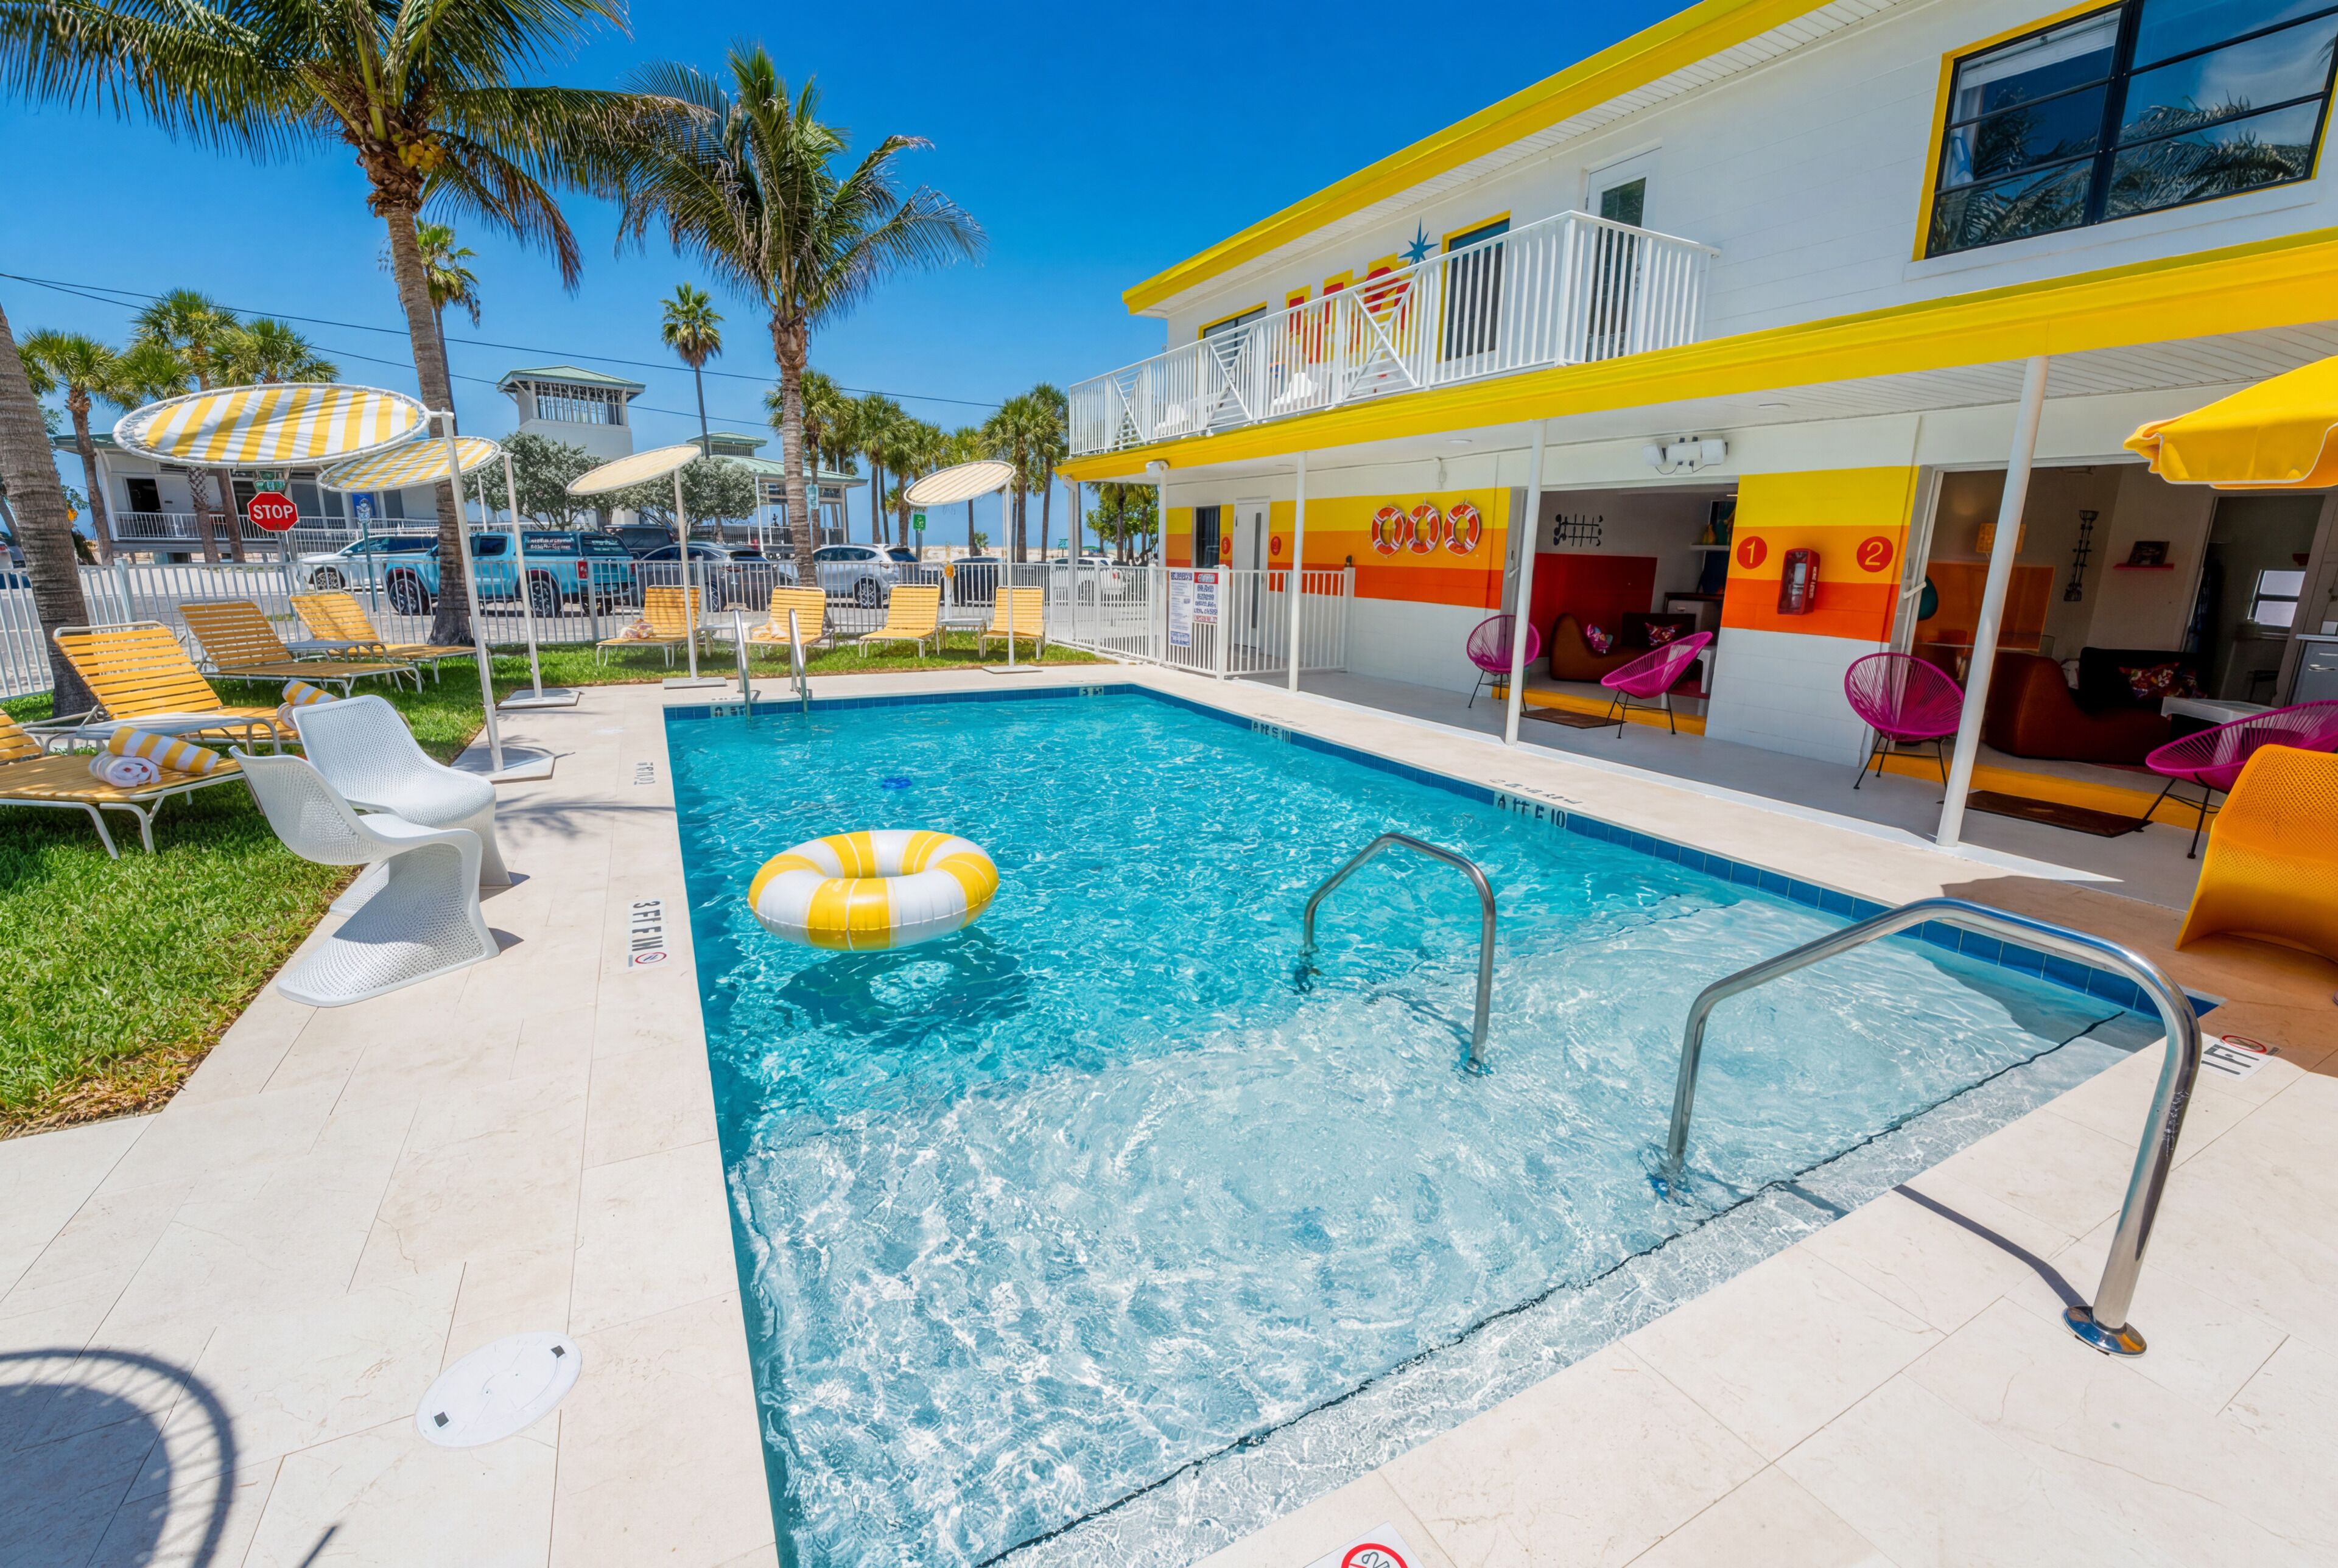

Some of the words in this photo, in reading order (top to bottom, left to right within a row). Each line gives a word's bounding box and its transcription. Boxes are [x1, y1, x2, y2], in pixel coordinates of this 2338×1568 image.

[253, 505, 293, 520] STOP
[1747, 541, 1756, 564] 1
[1865, 542, 1883, 565] 2
